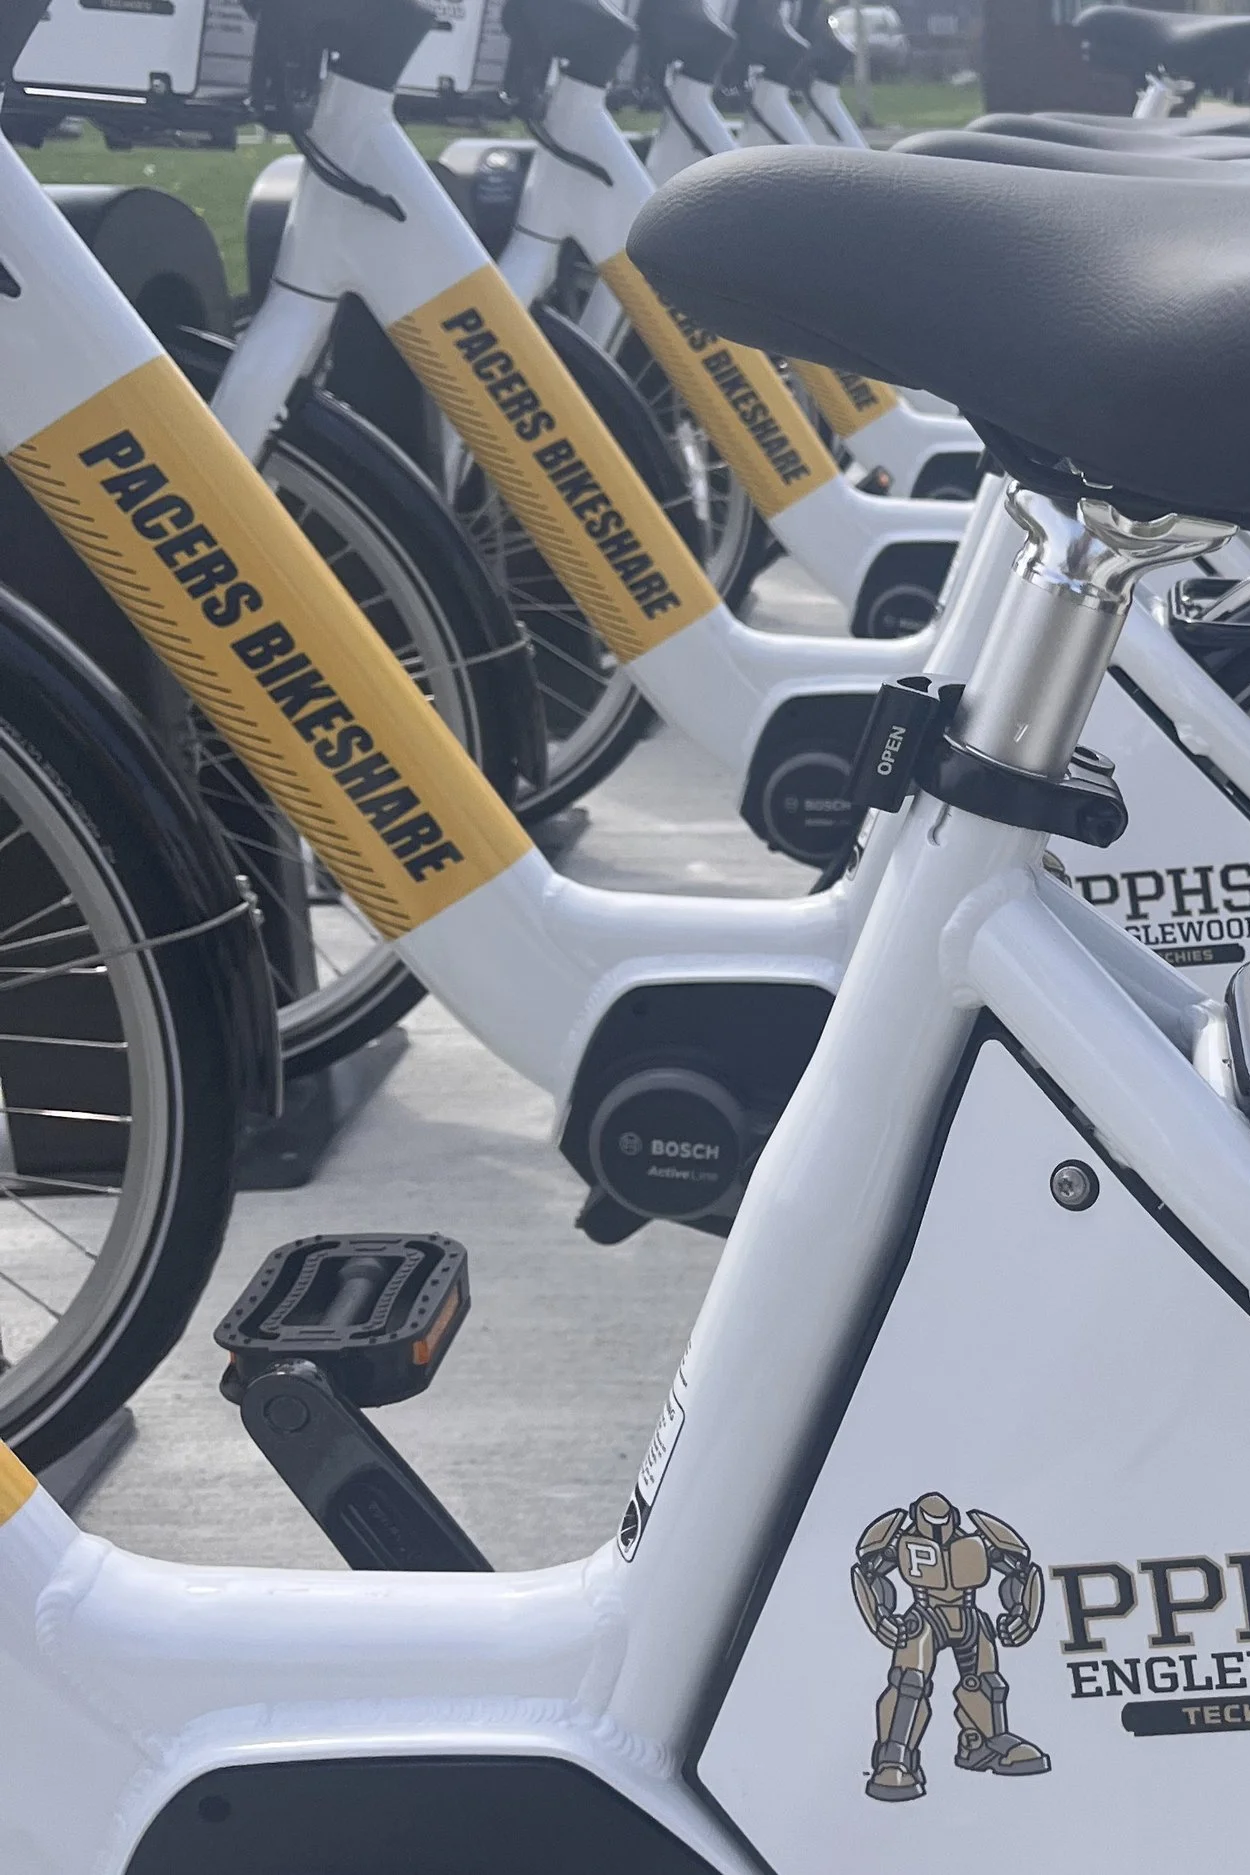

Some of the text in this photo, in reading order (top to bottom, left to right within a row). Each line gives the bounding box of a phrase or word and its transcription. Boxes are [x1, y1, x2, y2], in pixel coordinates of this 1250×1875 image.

[441, 306, 682, 621] PACERS BIKESHARE
[703, 349, 812, 486] BIKESHARE
[78, 429, 465, 884] PACERS BIKESHARE
[876, 725, 907, 776] OPEN
[1163, 948, 1214, 964] CHIES
[651, 1139, 720, 1160] BOSCH
